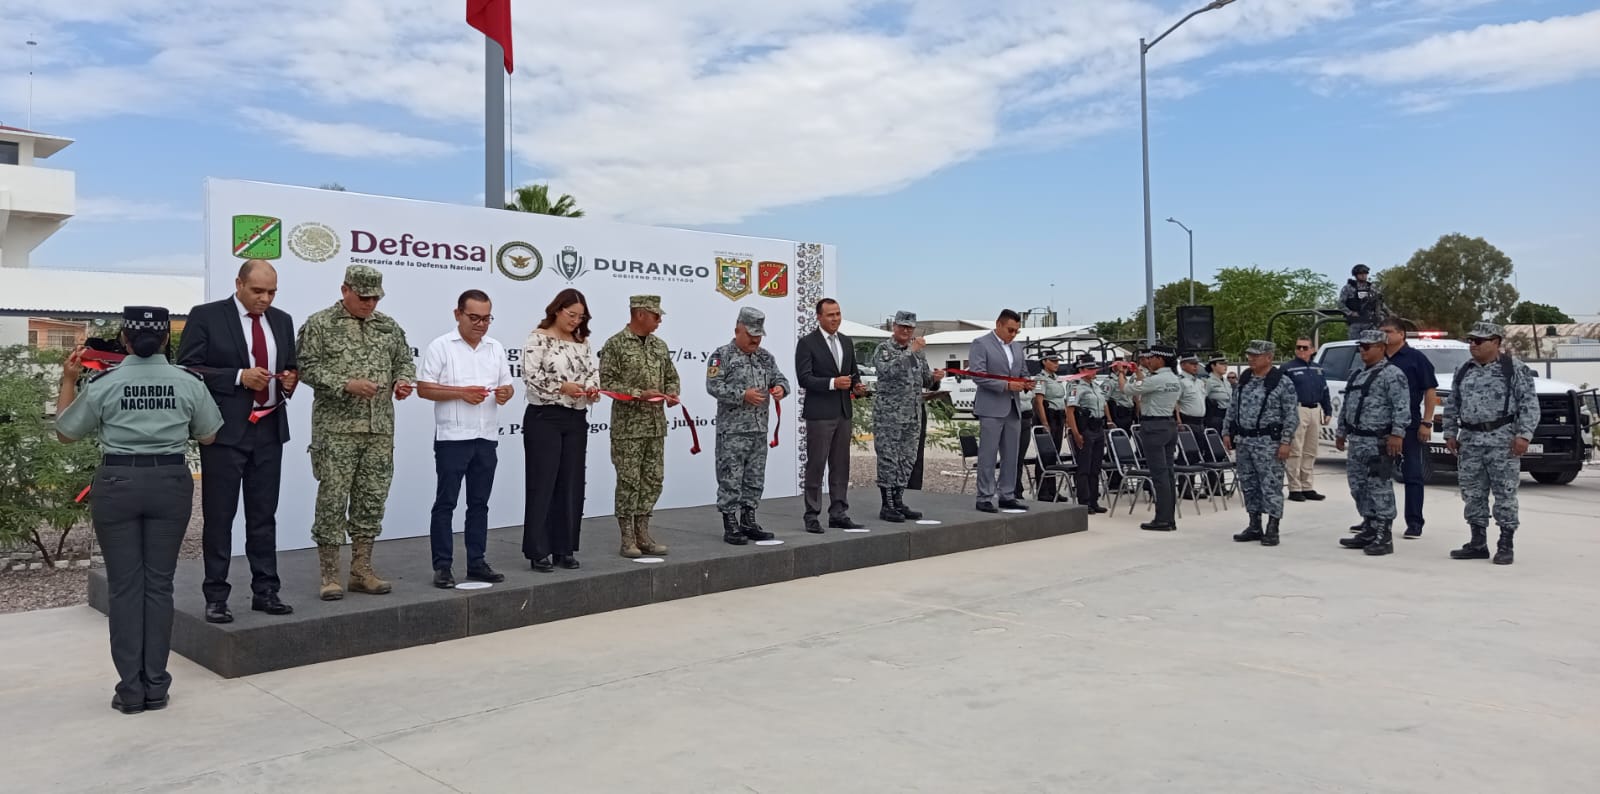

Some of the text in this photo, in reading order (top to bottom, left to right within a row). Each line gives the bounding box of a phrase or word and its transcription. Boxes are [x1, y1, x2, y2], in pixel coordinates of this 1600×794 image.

[350, 230, 486, 263] Defensa
[416, 261, 448, 270] Defensa
[450, 264, 483, 272] Nacional
[594, 258, 710, 278] DURANGO
[701, 351, 710, 363] y
[123, 385, 175, 398] GUARDIA
[120, 397, 177, 411] NACIONAL
[671, 415, 708, 430] juio
